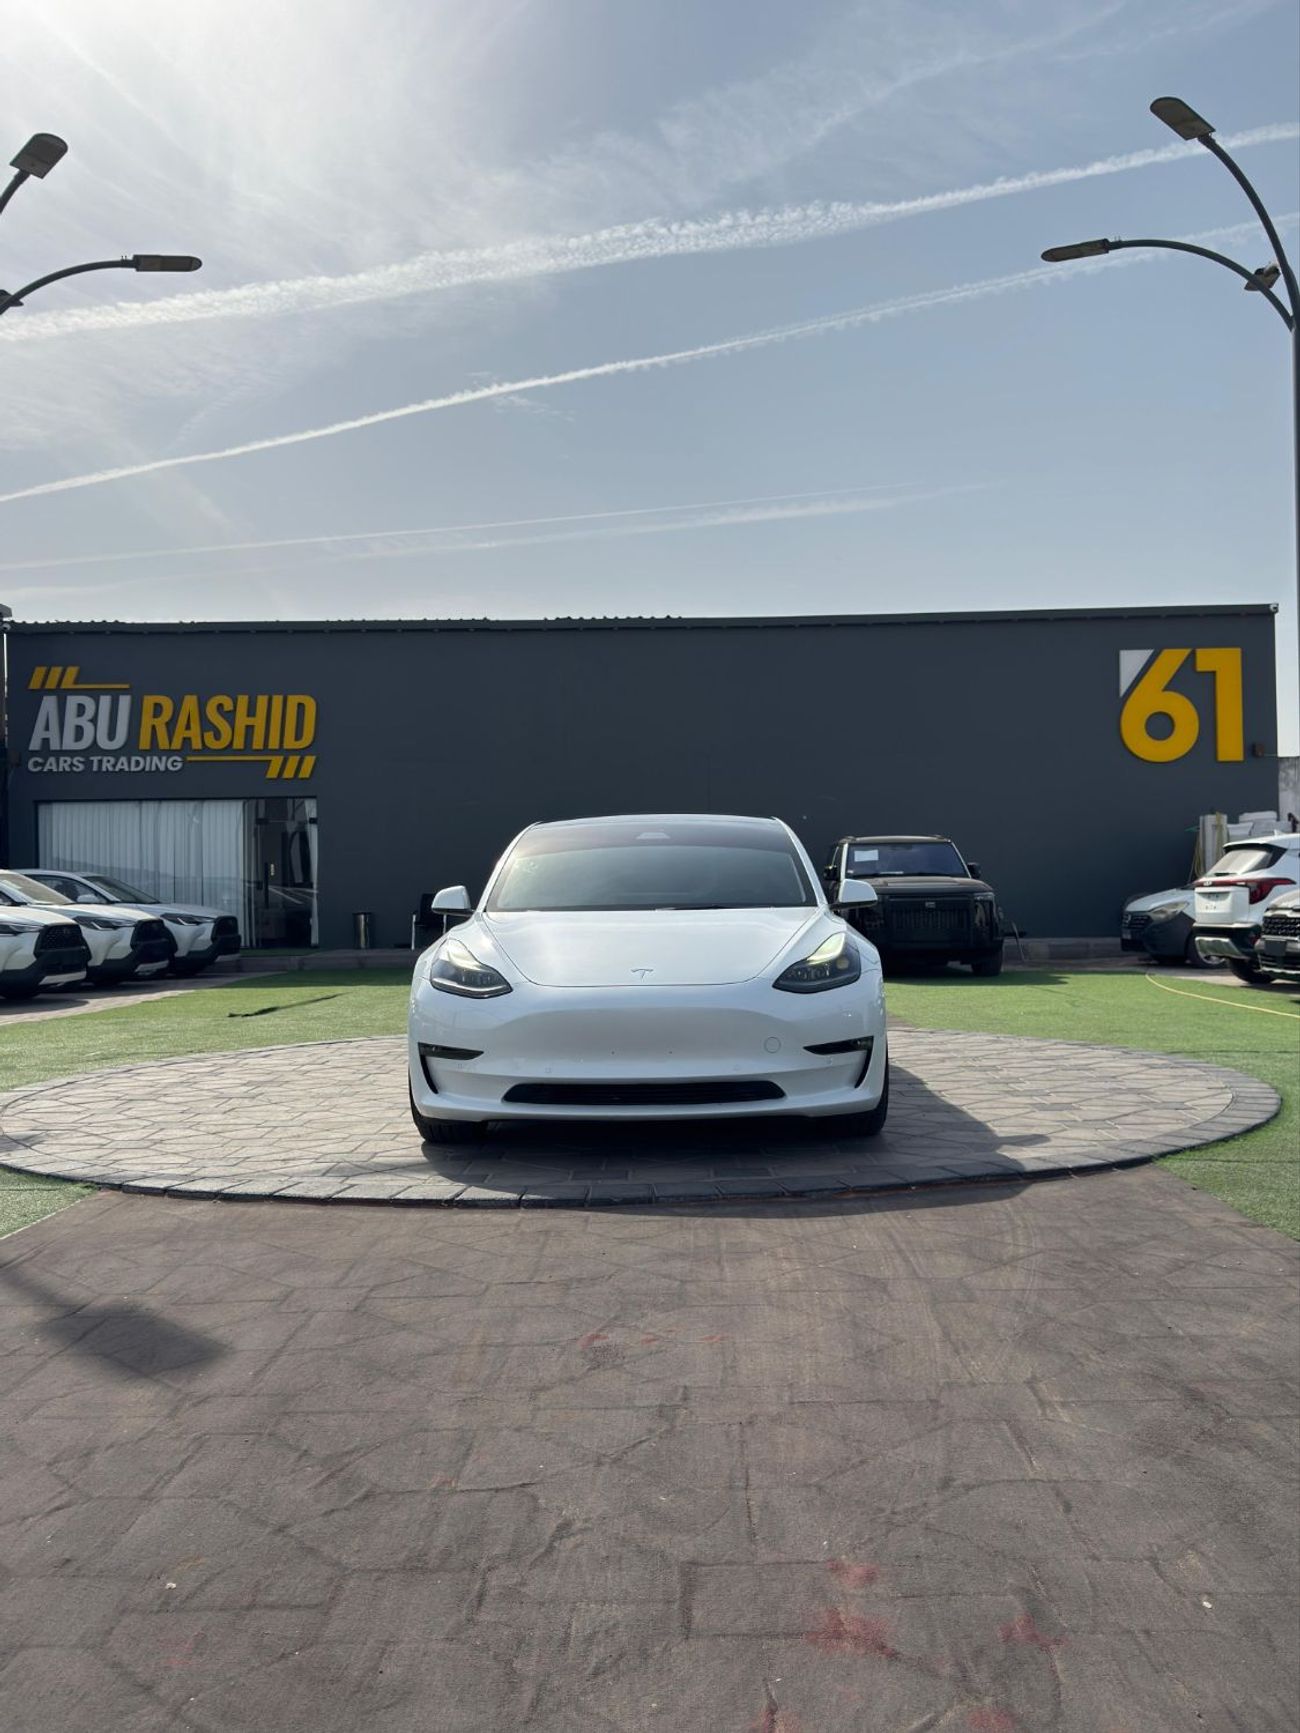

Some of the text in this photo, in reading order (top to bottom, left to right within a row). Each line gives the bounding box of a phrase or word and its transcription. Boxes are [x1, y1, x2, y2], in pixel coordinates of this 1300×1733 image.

[29, 694, 317, 750] ABU RASHID
[1120, 647, 1244, 762] 61
[27, 755, 184, 772] CARS TRADING
